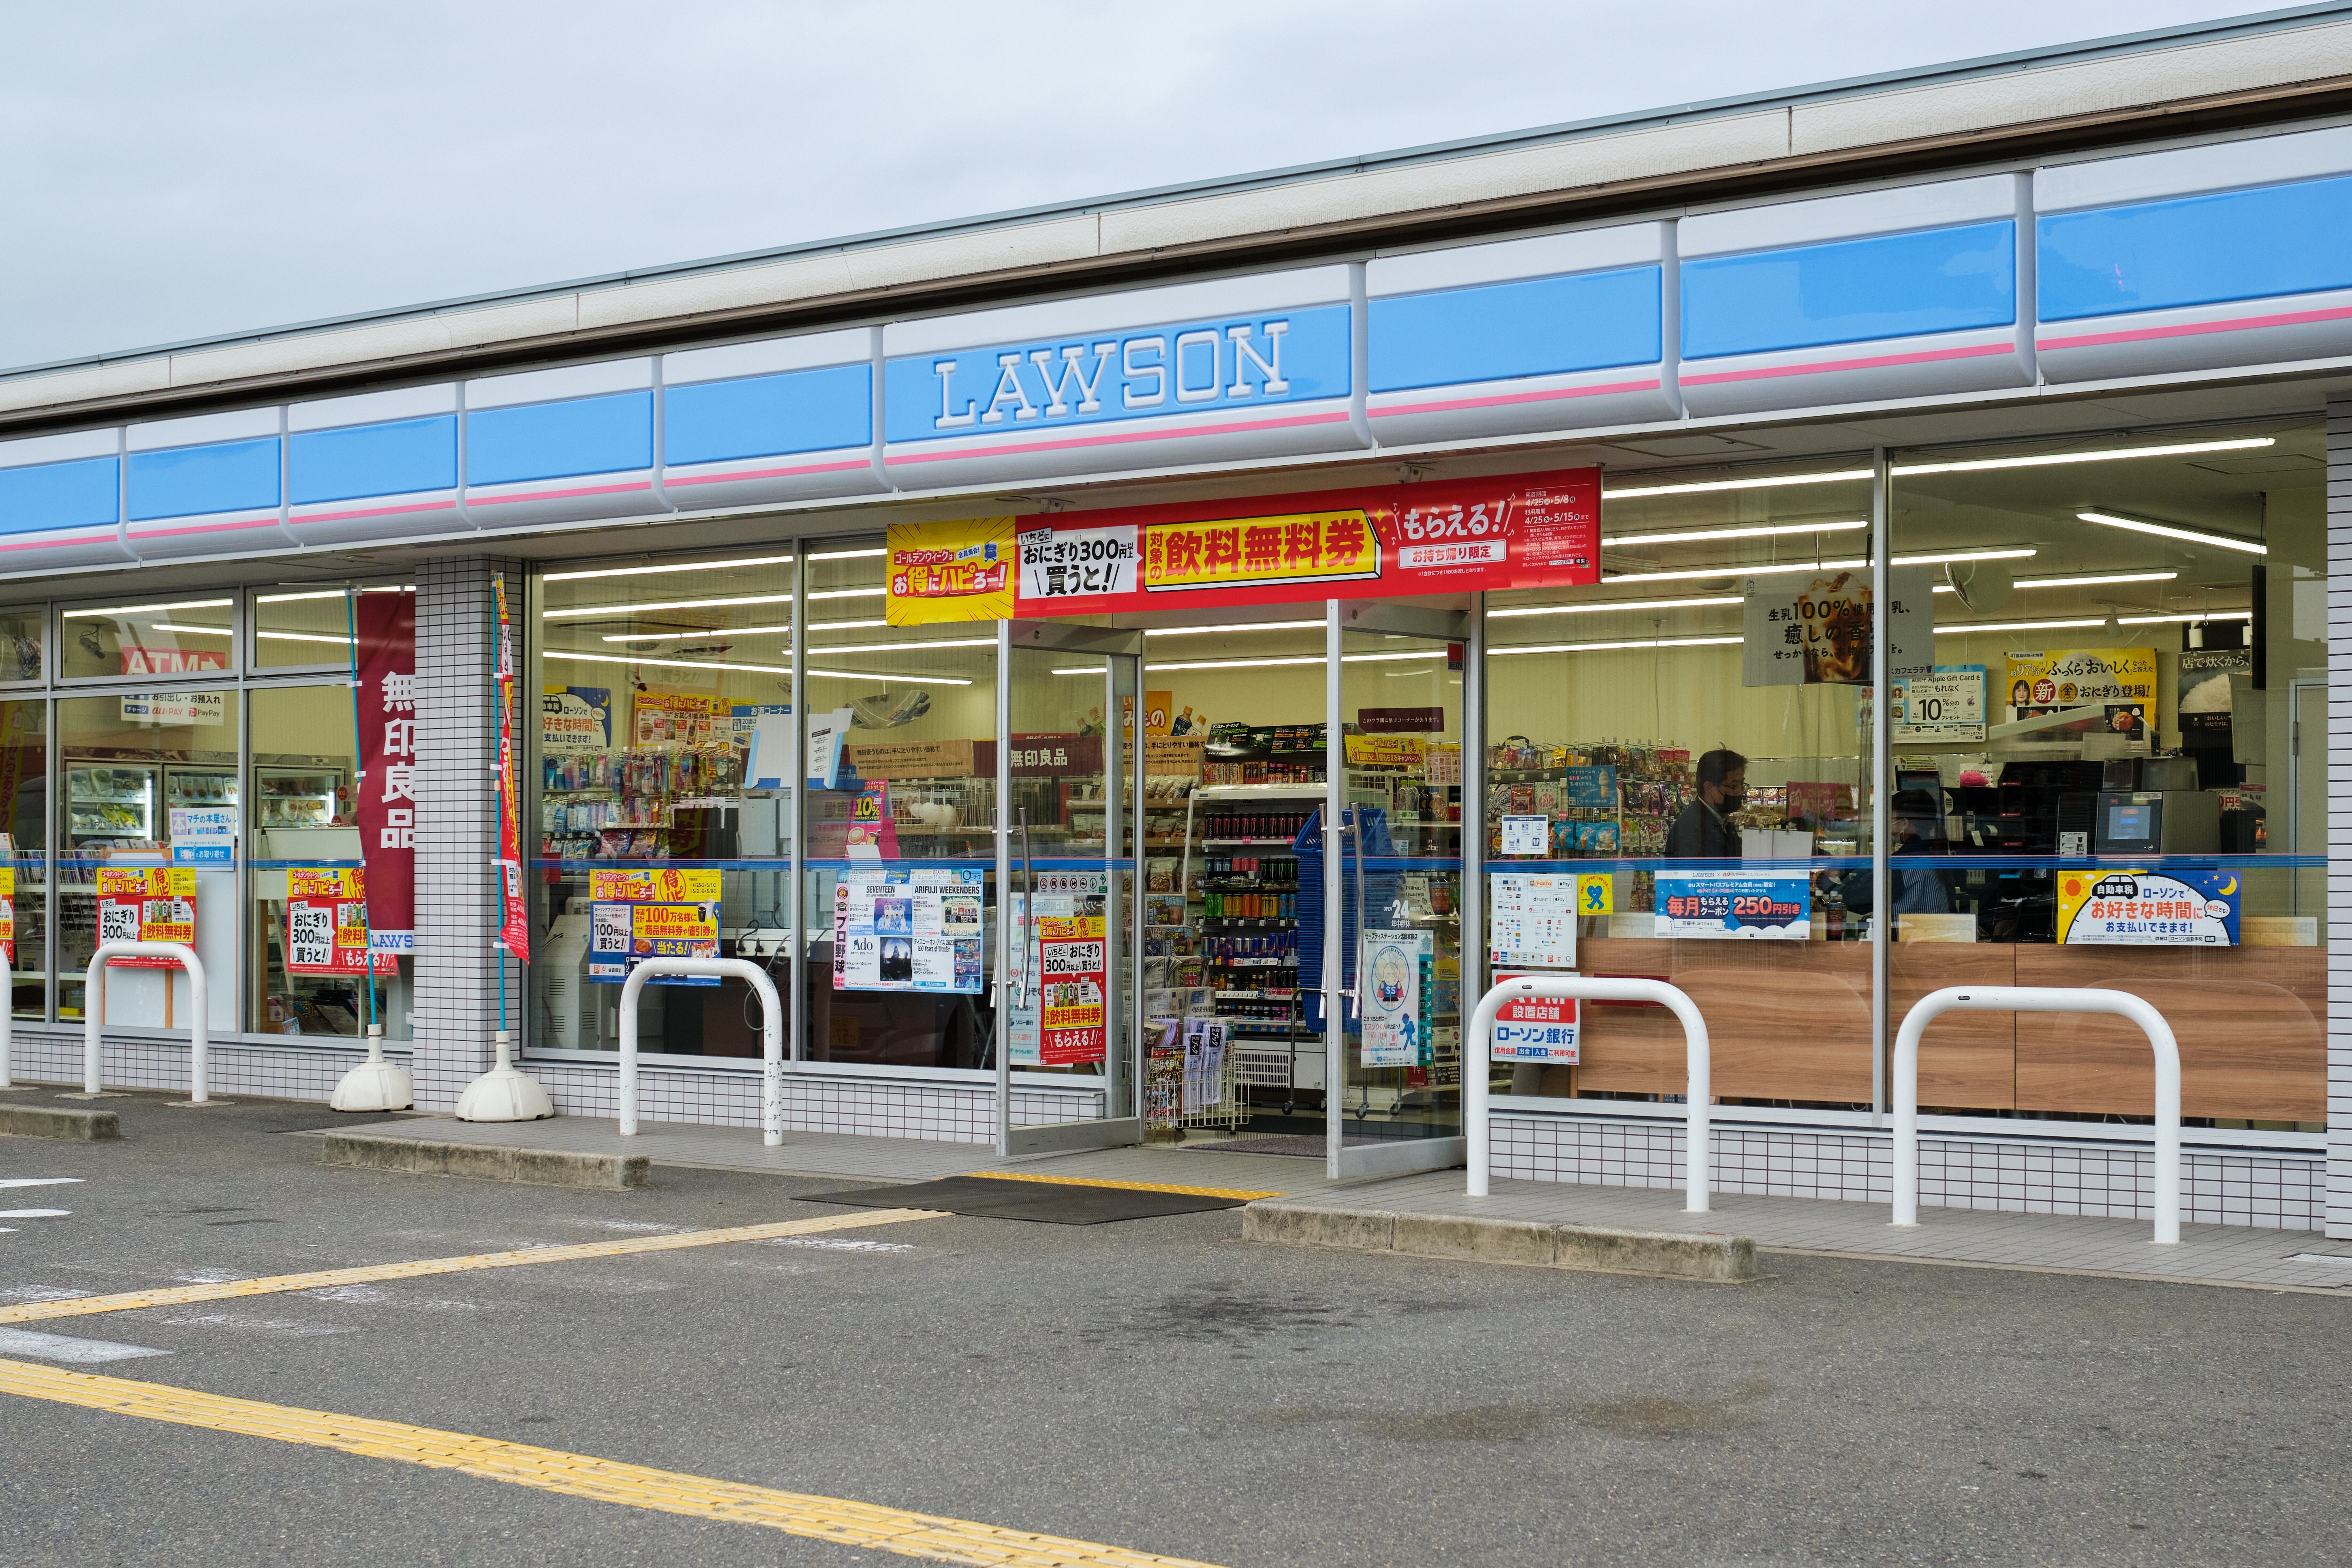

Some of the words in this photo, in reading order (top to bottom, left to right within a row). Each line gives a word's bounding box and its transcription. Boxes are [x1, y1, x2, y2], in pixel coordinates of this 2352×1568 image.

[934, 319, 1289, 430] LAWSON
[1404, 500, 1505, 539] もらえる!
[1021, 531, 1049, 544] いちどに
[896, 550, 953, 563] ゴールデンウィークは
[958, 547, 979, 558] 全員集合!
[1150, 531, 1163, 580] 対象の
[1165, 519, 1364, 577] 飲料無料券
[1413, 545, 1491, 563] お持ち帰り限定
[126, 651, 198, 674] ATM
[2183, 656, 2249, 669] 店で炊くから、
[2036, 682, 2053, 700] 新
[2080, 685, 2150, 697] おにぎり登場!
[751, 707, 789, 715] お酒コーナー
[543, 717, 599, 732] 好きな時間に
[544, 733, 590, 743] 支払いできます!
[857, 746, 942, 755] 毎日使うものは、手にとりやすい価格で。
[1011, 748, 1067, 768] 無印良品
[381, 671, 415, 848] 無印良品
[855, 797, 879, 815] 10%
[173, 814, 185, 833] 本
[187, 813, 231, 824] マチの本屋さん
[2097, 885, 2133, 894] 自動車税
[2143, 888, 2184, 898] ローソンで
[1667, 896, 1699, 916] 毎月
[1733, 896, 1800, 915] 250円引き
[1700, 896, 1729, 905] もらえる
[104, 909, 134, 924] おにぎり
[1392, 900, 1409, 918] 24
[1700, 907, 1729, 916] クーポン
[2091, 901, 2202, 919] お好きな時間に
[2208, 904, 2228, 914] 休日でも!
[295, 912, 327, 928] おにぎり
[2106, 922, 2192, 933] お支払いできます!
[103, 925, 135, 939] 300円以上
[147, 924, 191, 939] 飲料無料券
[293, 929, 330, 944] 300円以上
[595, 924, 628, 936] 100円以上
[645, 925, 716, 935] 商品無料券や値引券が
[371, 935, 413, 948] LAWS
[657, 941, 687, 954] 当たる!
[835, 916, 847, 973] プロ野球
[853, 938, 872, 950] Ado
[1048, 947, 1066, 956] いちどに
[1070, 943, 1099, 958] おにぎり
[1379, 949, 1390, 957] SAFETY
[1391, 948, 1402, 957] STATION
[1046, 959, 1079, 972] 300円以上
[1050, 1008, 1100, 1025] 飲料無料券
[1513, 1005, 1559, 1019] 設置店舗
[1055, 1030, 1095, 1047] もらえる!
[1497, 1027, 1574, 1044] ローソン銀行
